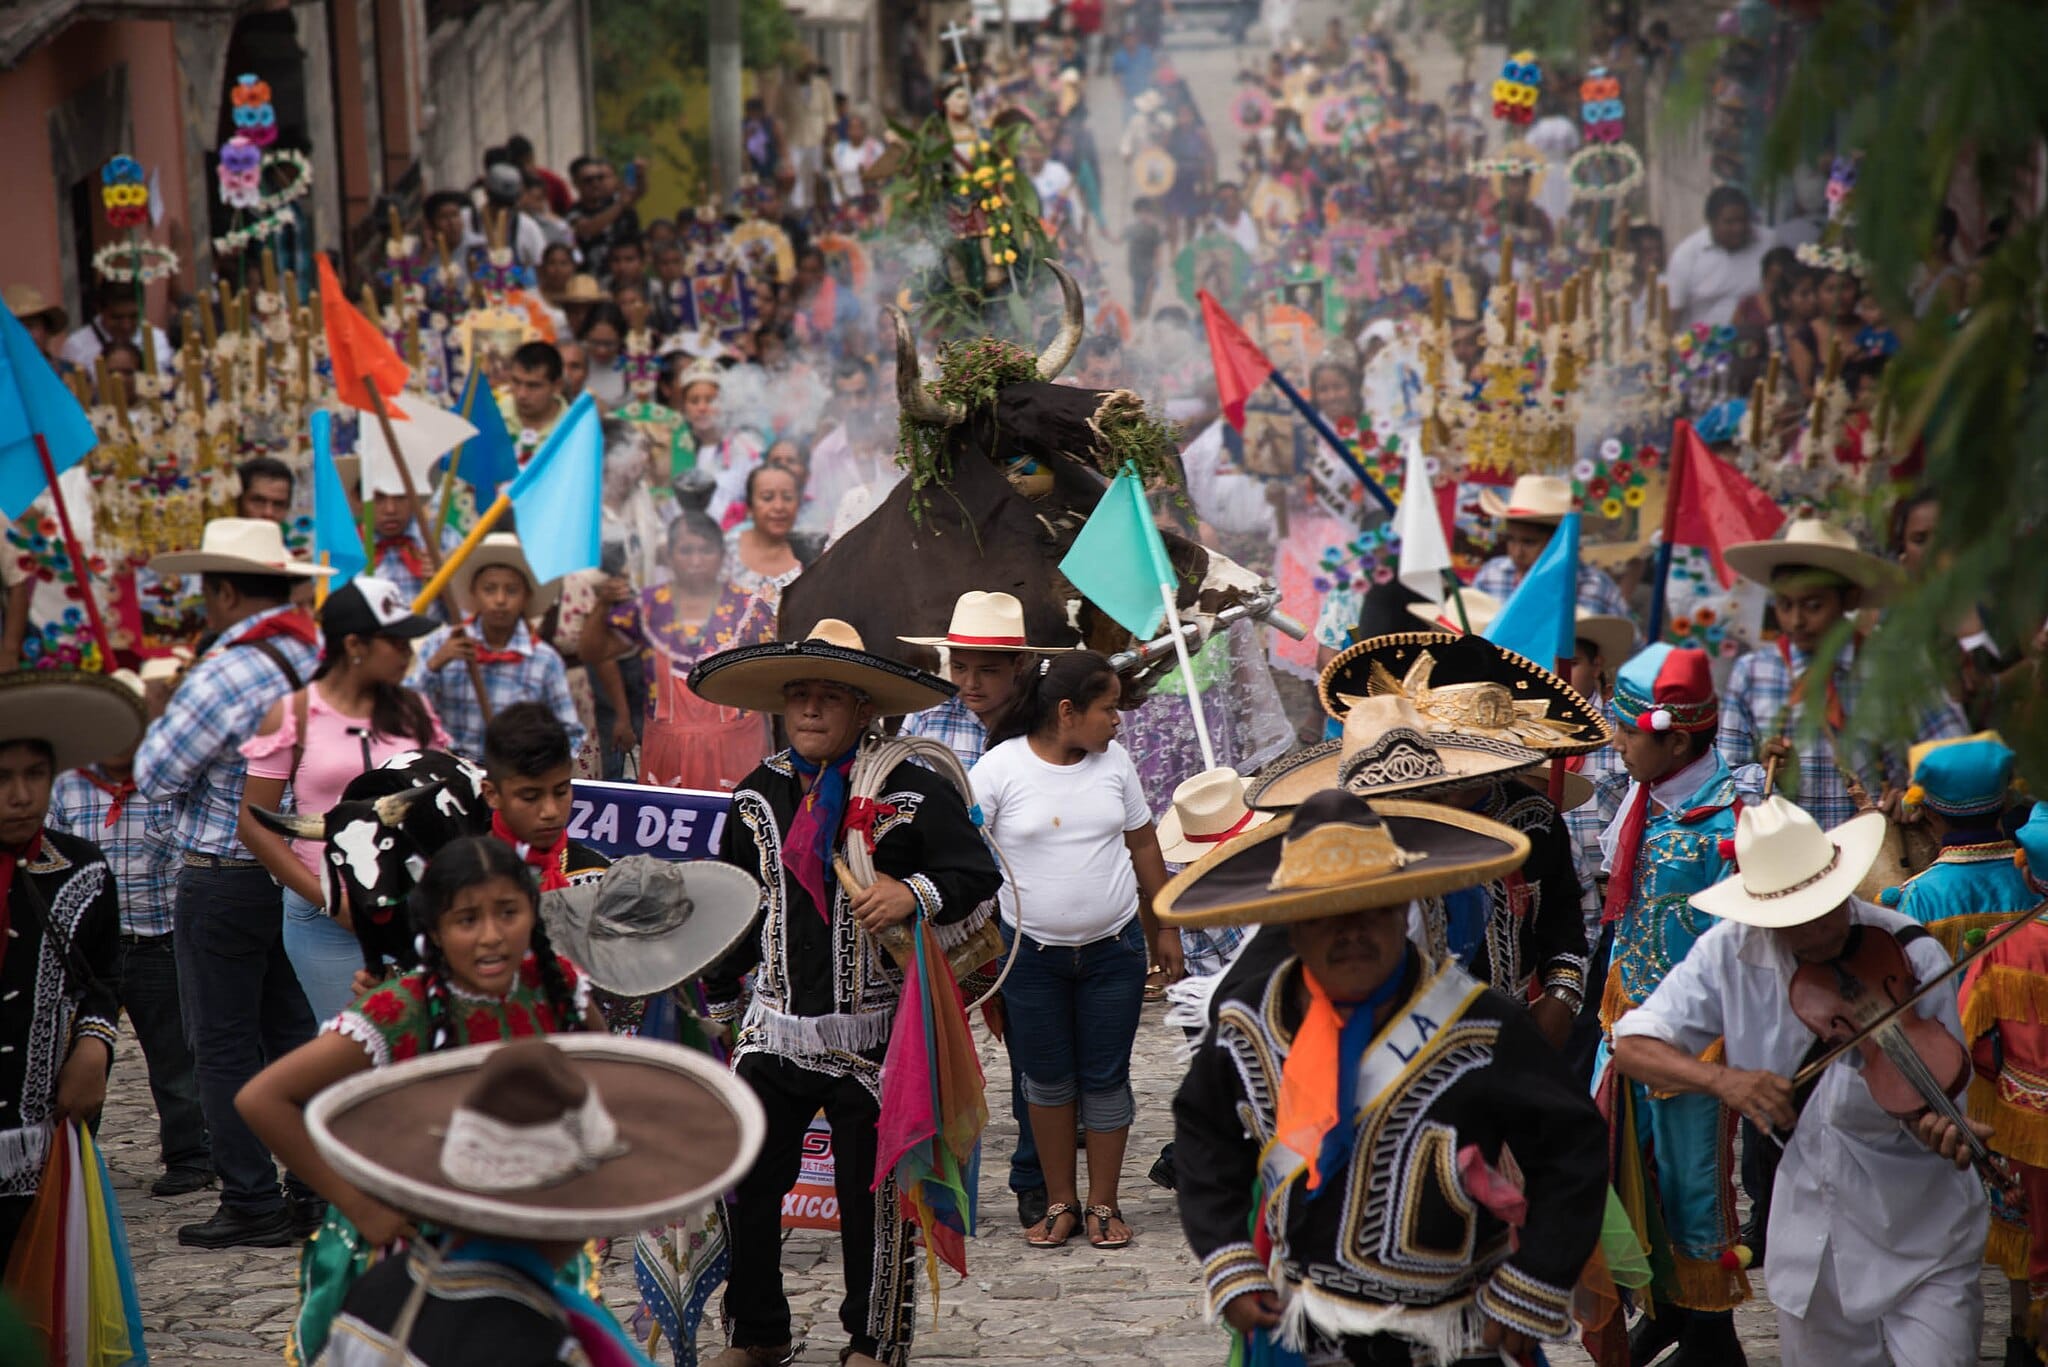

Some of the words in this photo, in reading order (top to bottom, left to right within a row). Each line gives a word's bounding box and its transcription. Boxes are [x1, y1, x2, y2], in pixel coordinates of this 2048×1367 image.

[567, 800, 619, 844] ZA
[635, 805, 698, 852] DE
[1385, 1013, 1439, 1064] LA
